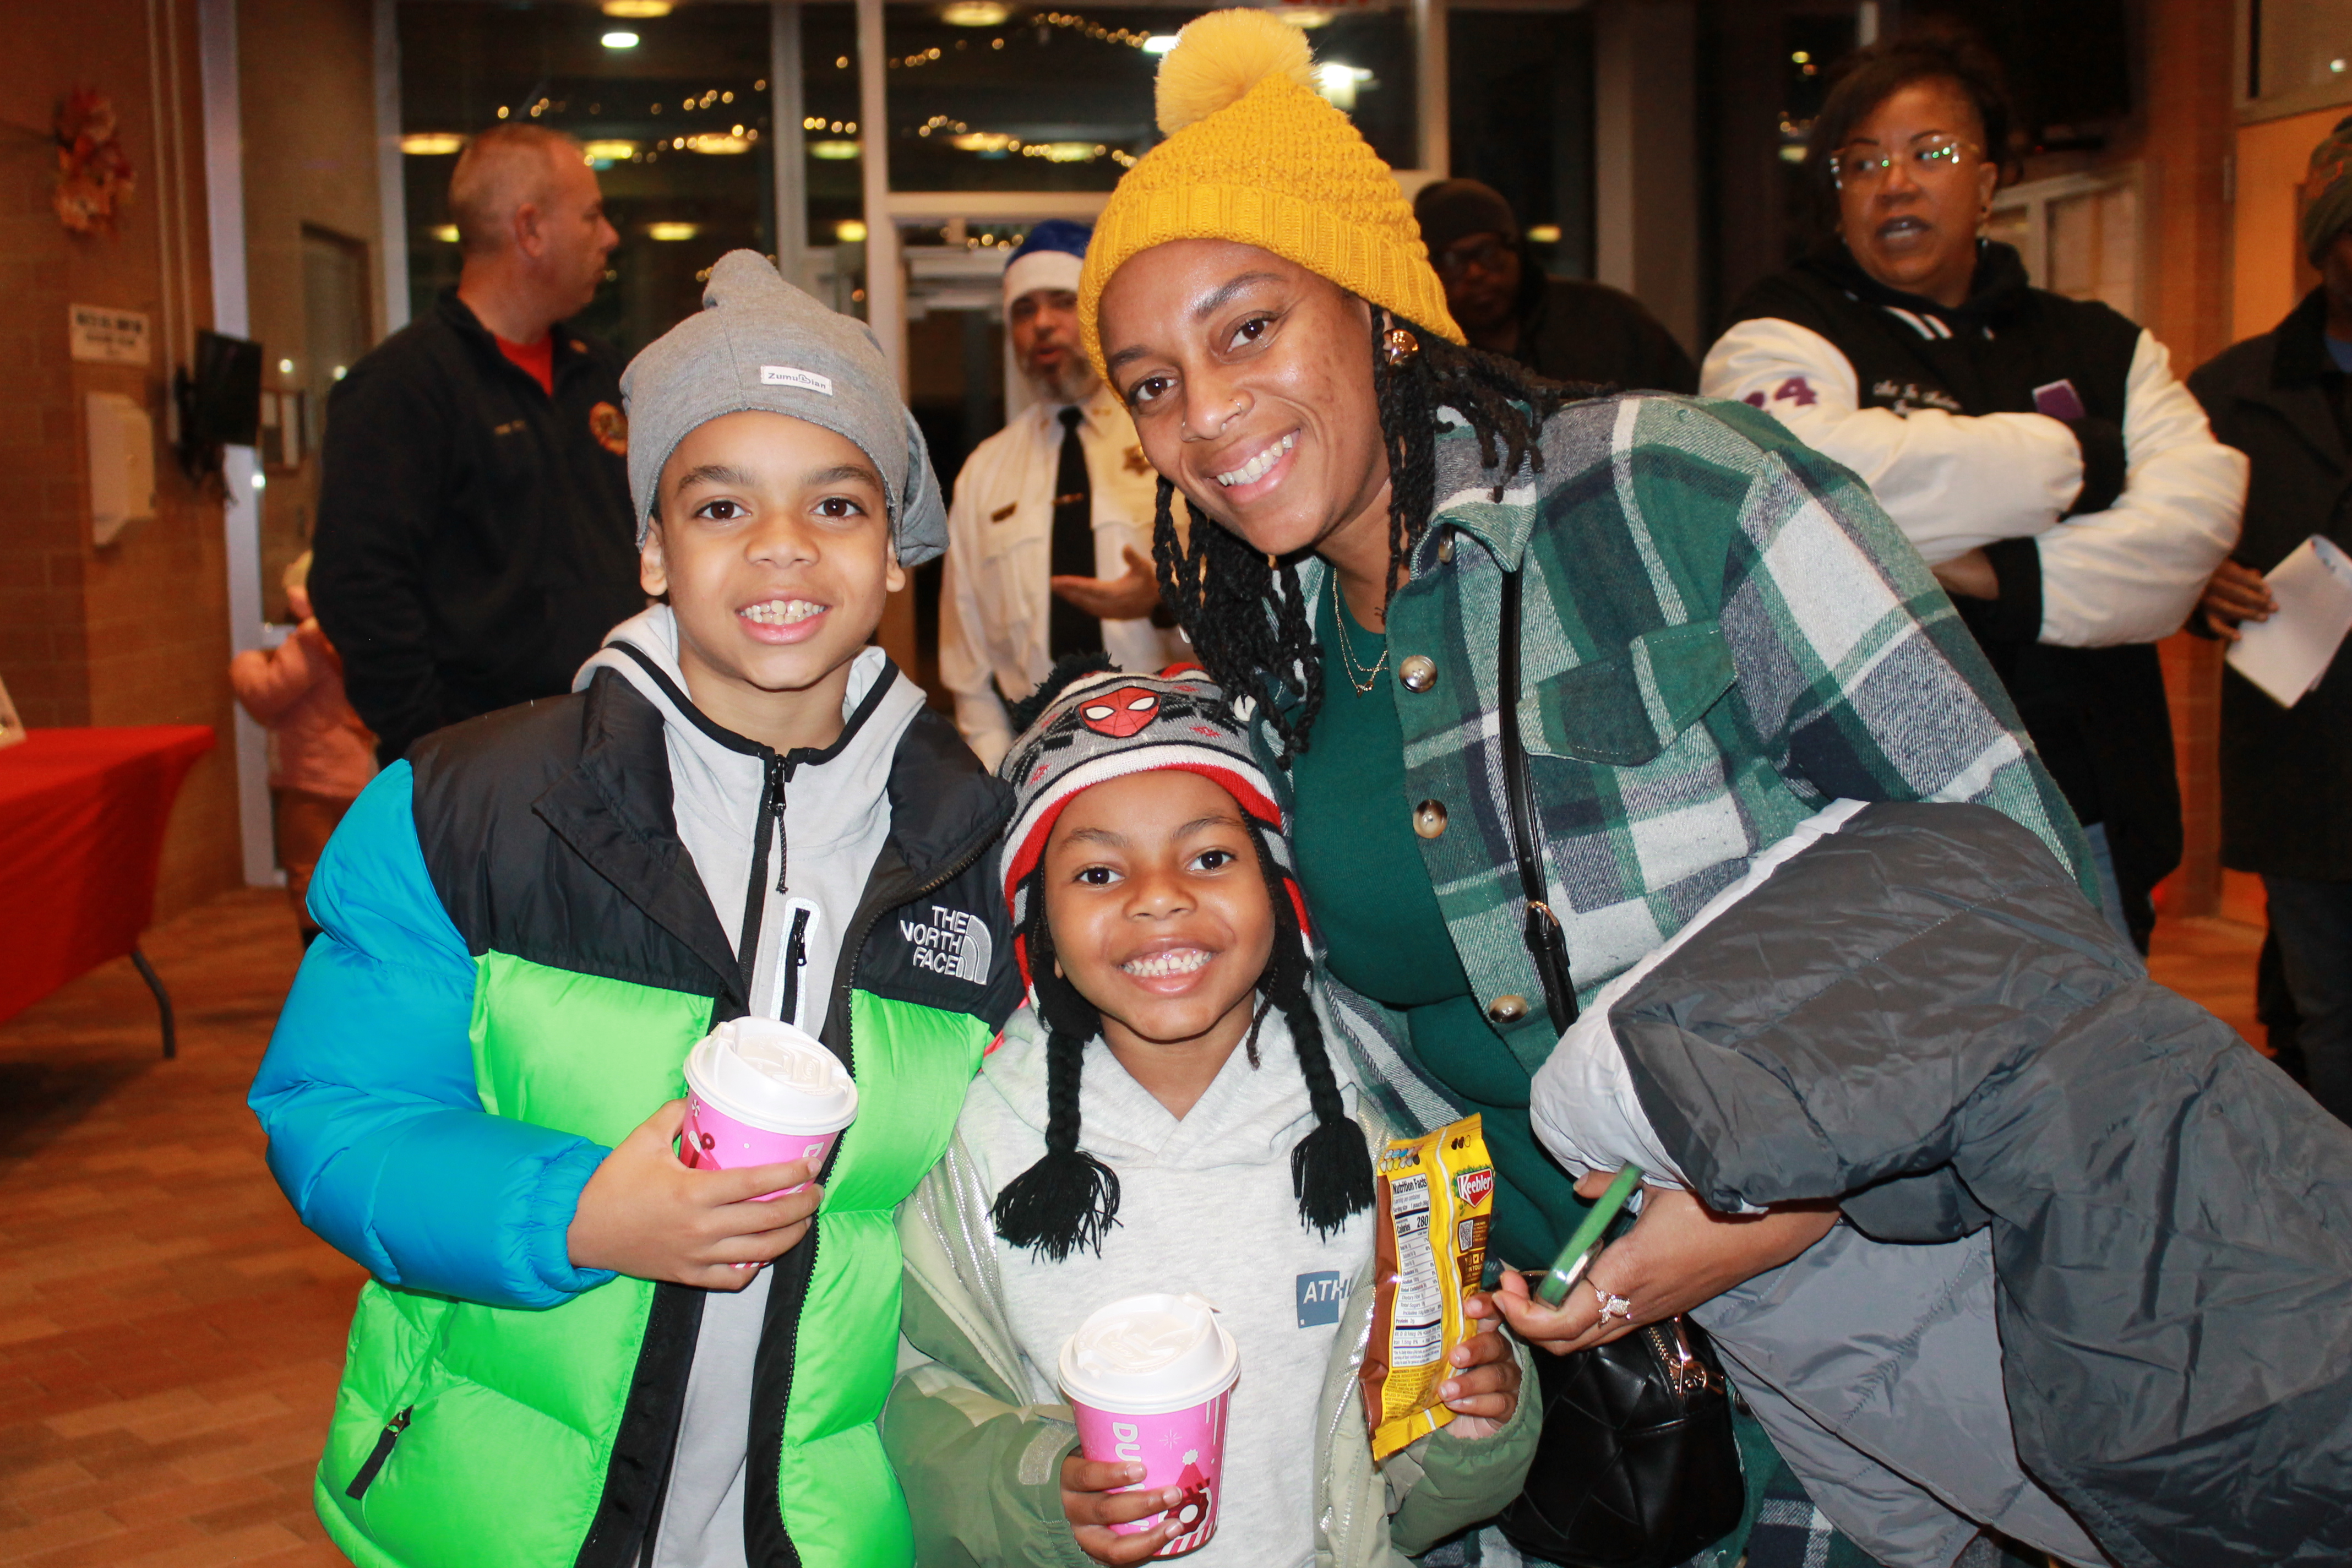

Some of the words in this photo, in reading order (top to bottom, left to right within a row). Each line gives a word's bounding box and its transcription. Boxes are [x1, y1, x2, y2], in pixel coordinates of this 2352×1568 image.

[932, 905, 970, 934] THE
[900, 919, 963, 955] NORTH
[913, 946, 960, 976] FACE
[1392, 1180, 1414, 1195] Nutrition
[1413, 1177, 1427, 1190] Facts
[1460, 1174, 1491, 1199] Keebler
[1397, 1223, 1411, 1234] Calories
[1417, 1215, 1429, 1228] 280
